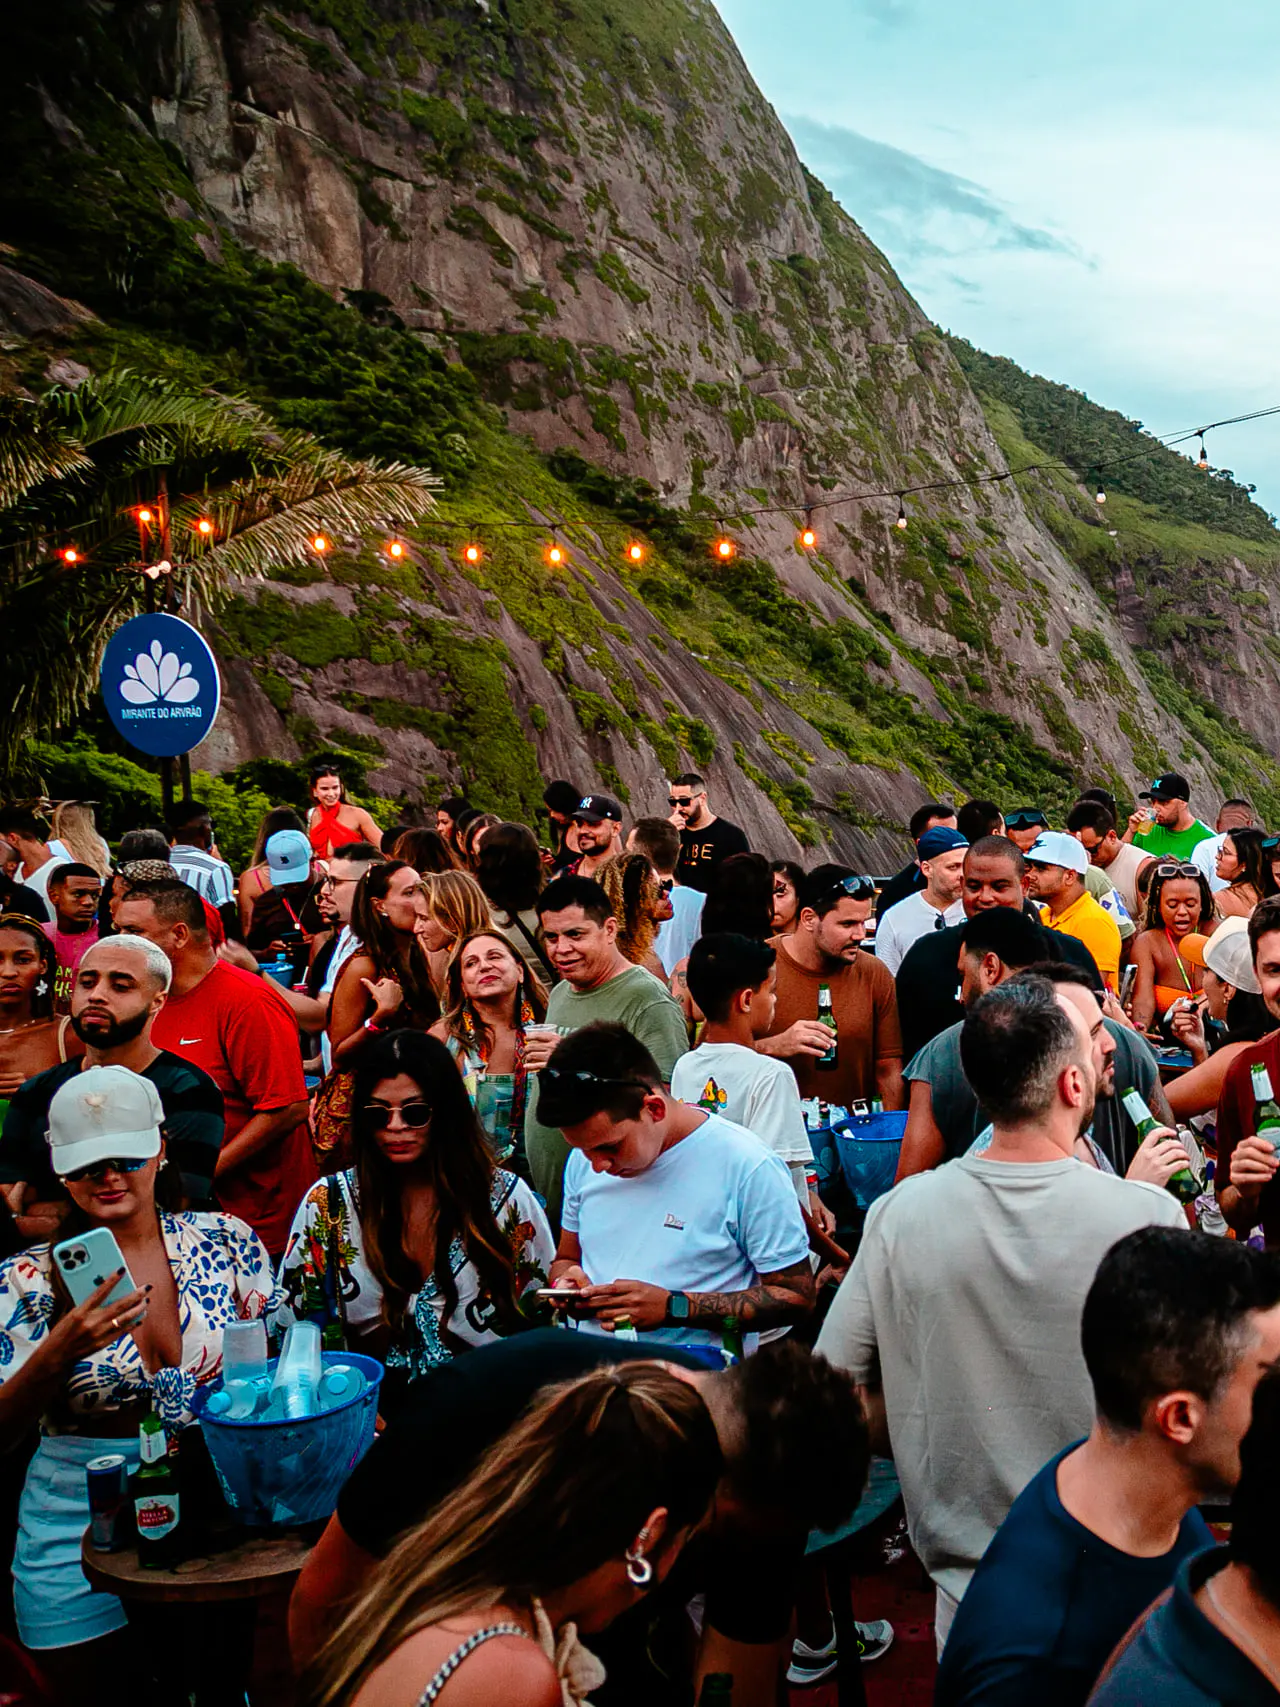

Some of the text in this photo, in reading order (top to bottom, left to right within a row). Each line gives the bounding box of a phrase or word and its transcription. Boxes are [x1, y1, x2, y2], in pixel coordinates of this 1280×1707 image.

[121, 704, 202, 719] MIRANTE DO ARVRÃO
